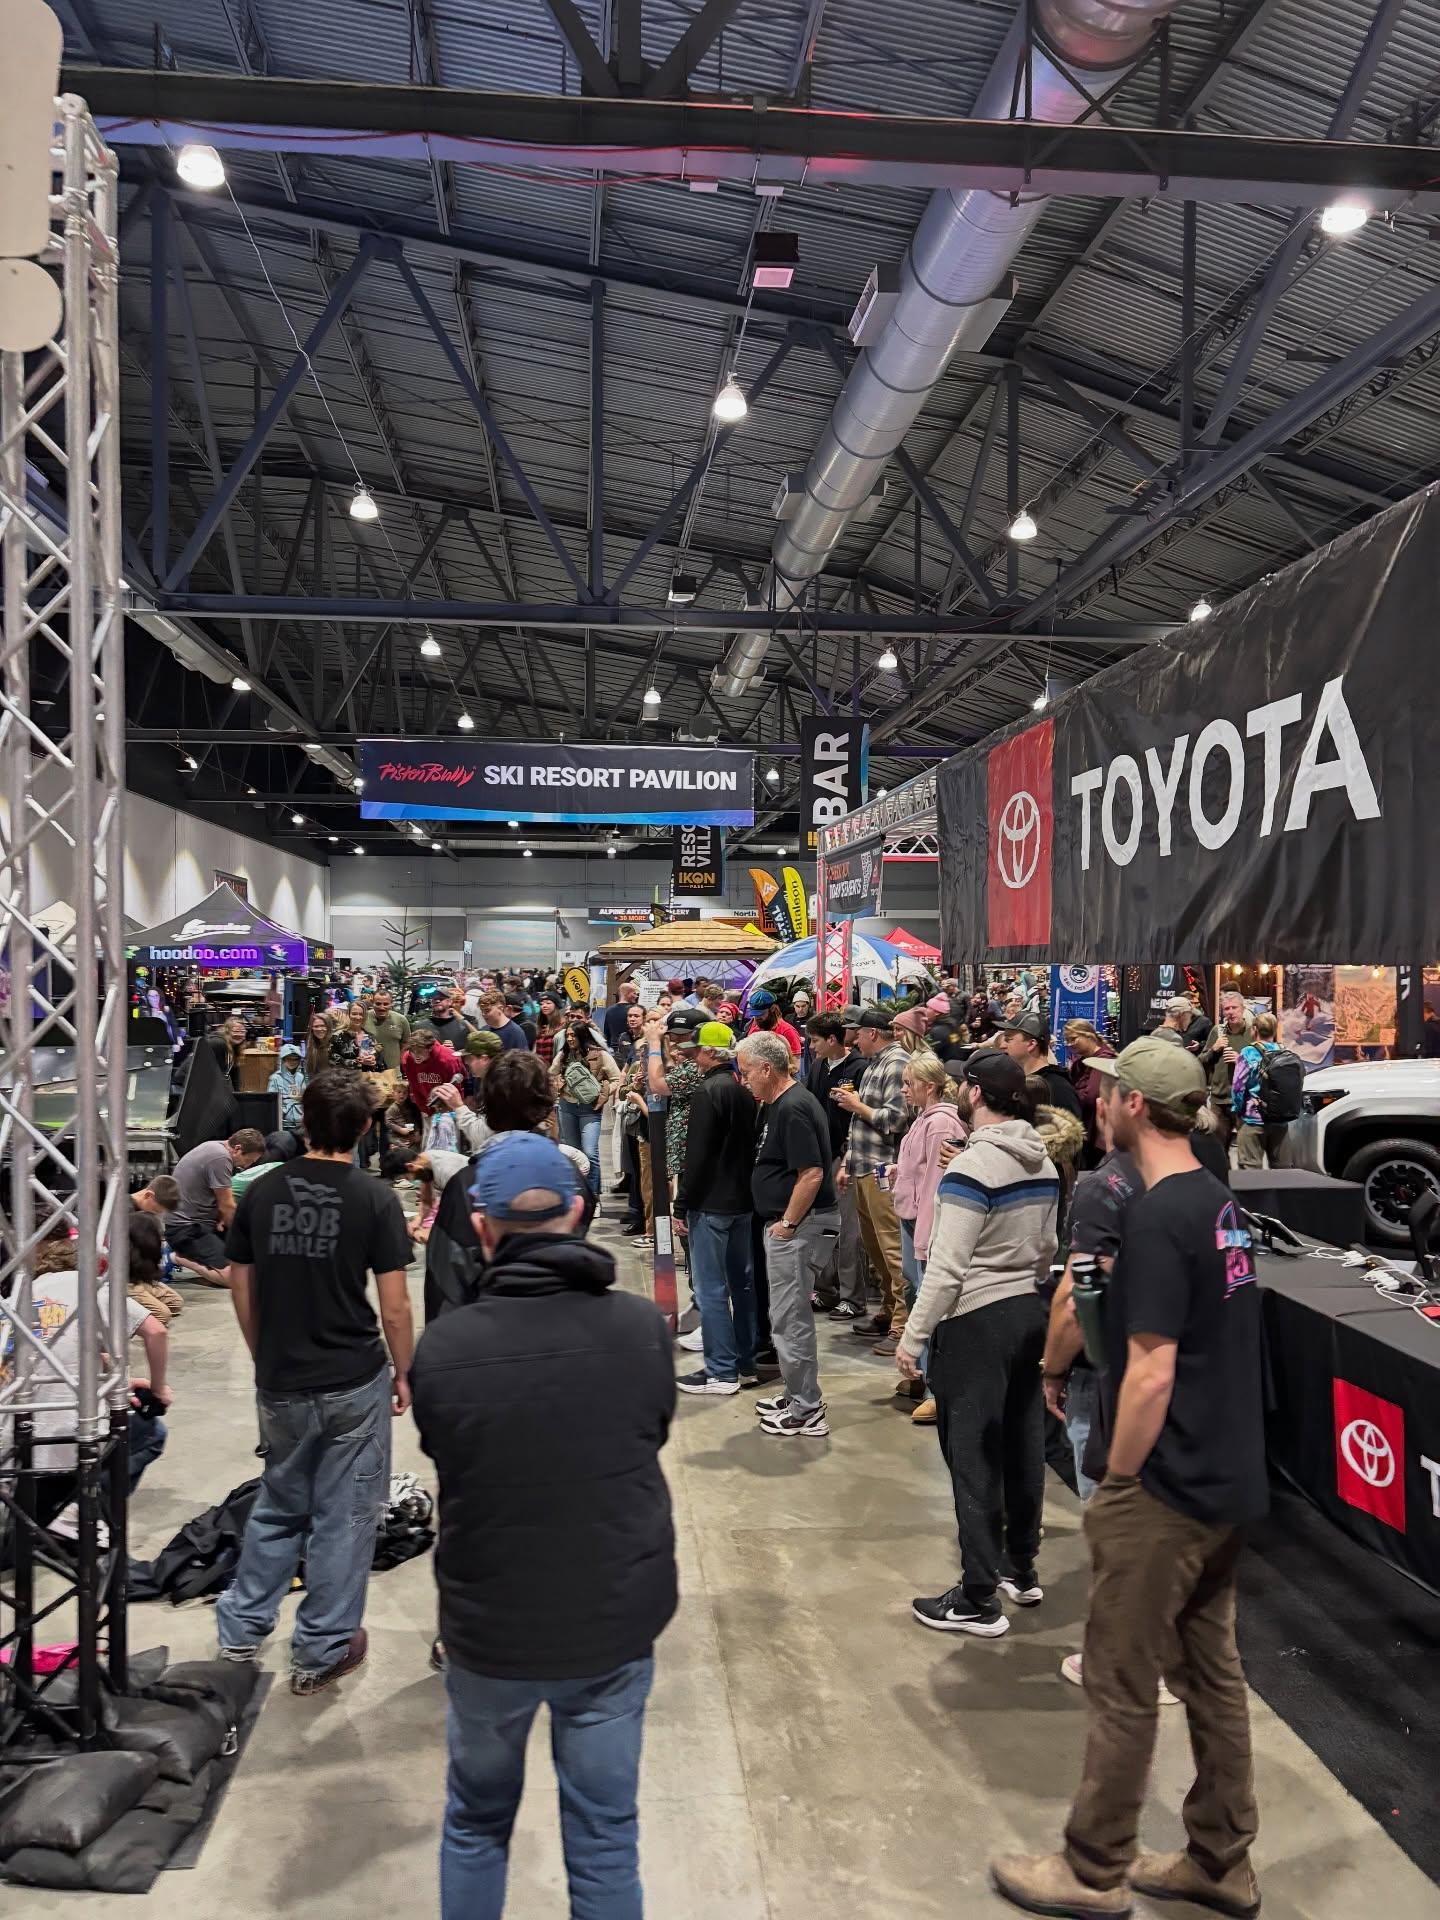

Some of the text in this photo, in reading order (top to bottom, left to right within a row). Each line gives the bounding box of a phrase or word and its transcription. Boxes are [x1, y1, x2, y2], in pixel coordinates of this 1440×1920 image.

[378, 762, 476, 788] PistonBully
[484, 765, 737, 791] SKI RESORT PAVILION
[812, 732, 849, 825] BAR
[1071, 675, 1381, 871] TOYOTA
[678, 872, 715, 885] IKON
[149, 945, 258, 960] hoodoo.com
[271, 1203, 341, 1237] BOB
